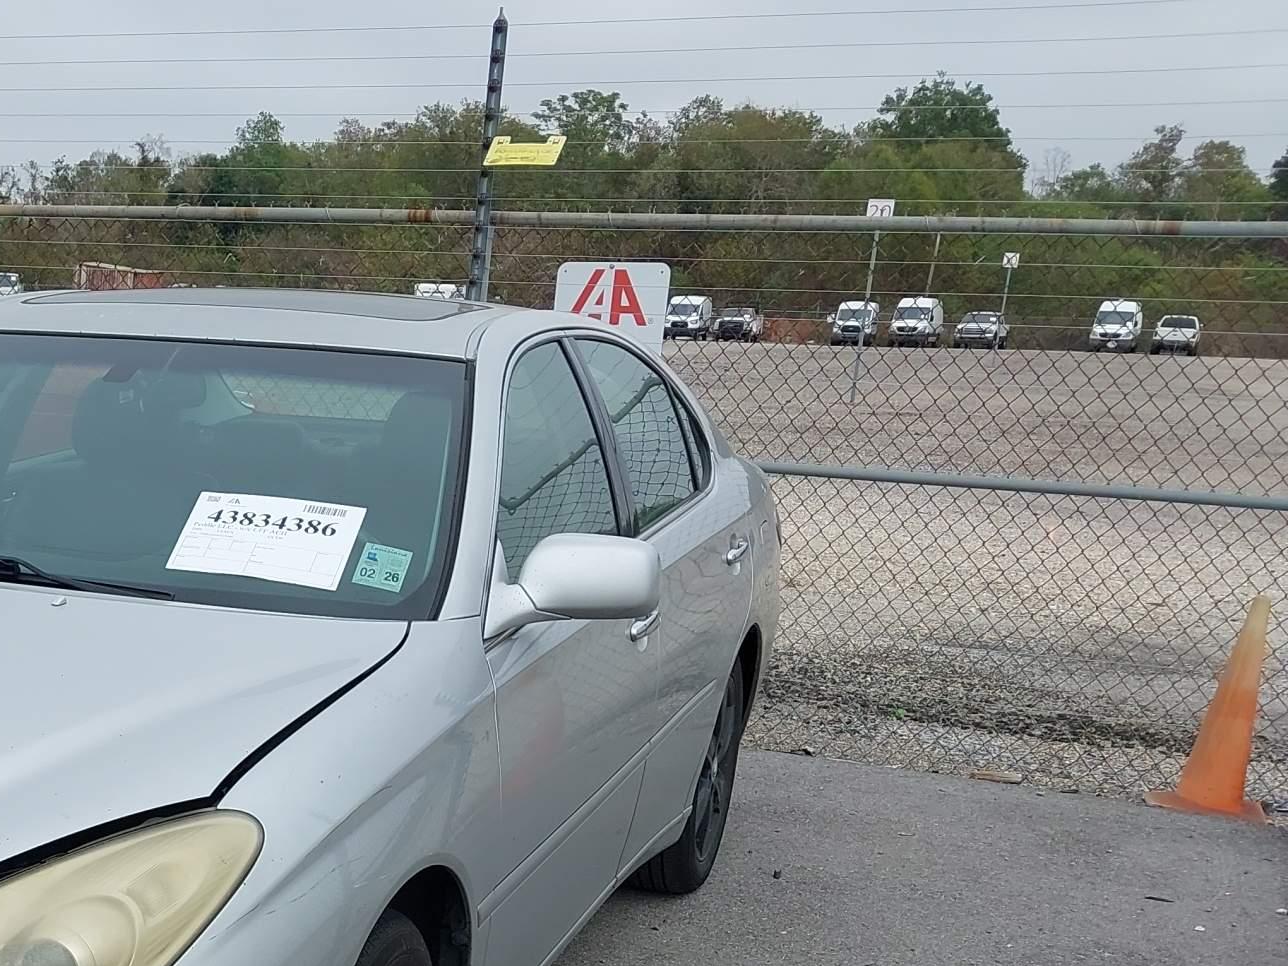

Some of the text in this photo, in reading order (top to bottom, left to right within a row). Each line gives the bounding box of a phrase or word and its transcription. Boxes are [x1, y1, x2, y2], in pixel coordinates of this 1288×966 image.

[207, 508, 340, 537] 43834386
[359, 567, 376, 579] 02
[384, 571, 400, 583] 26
